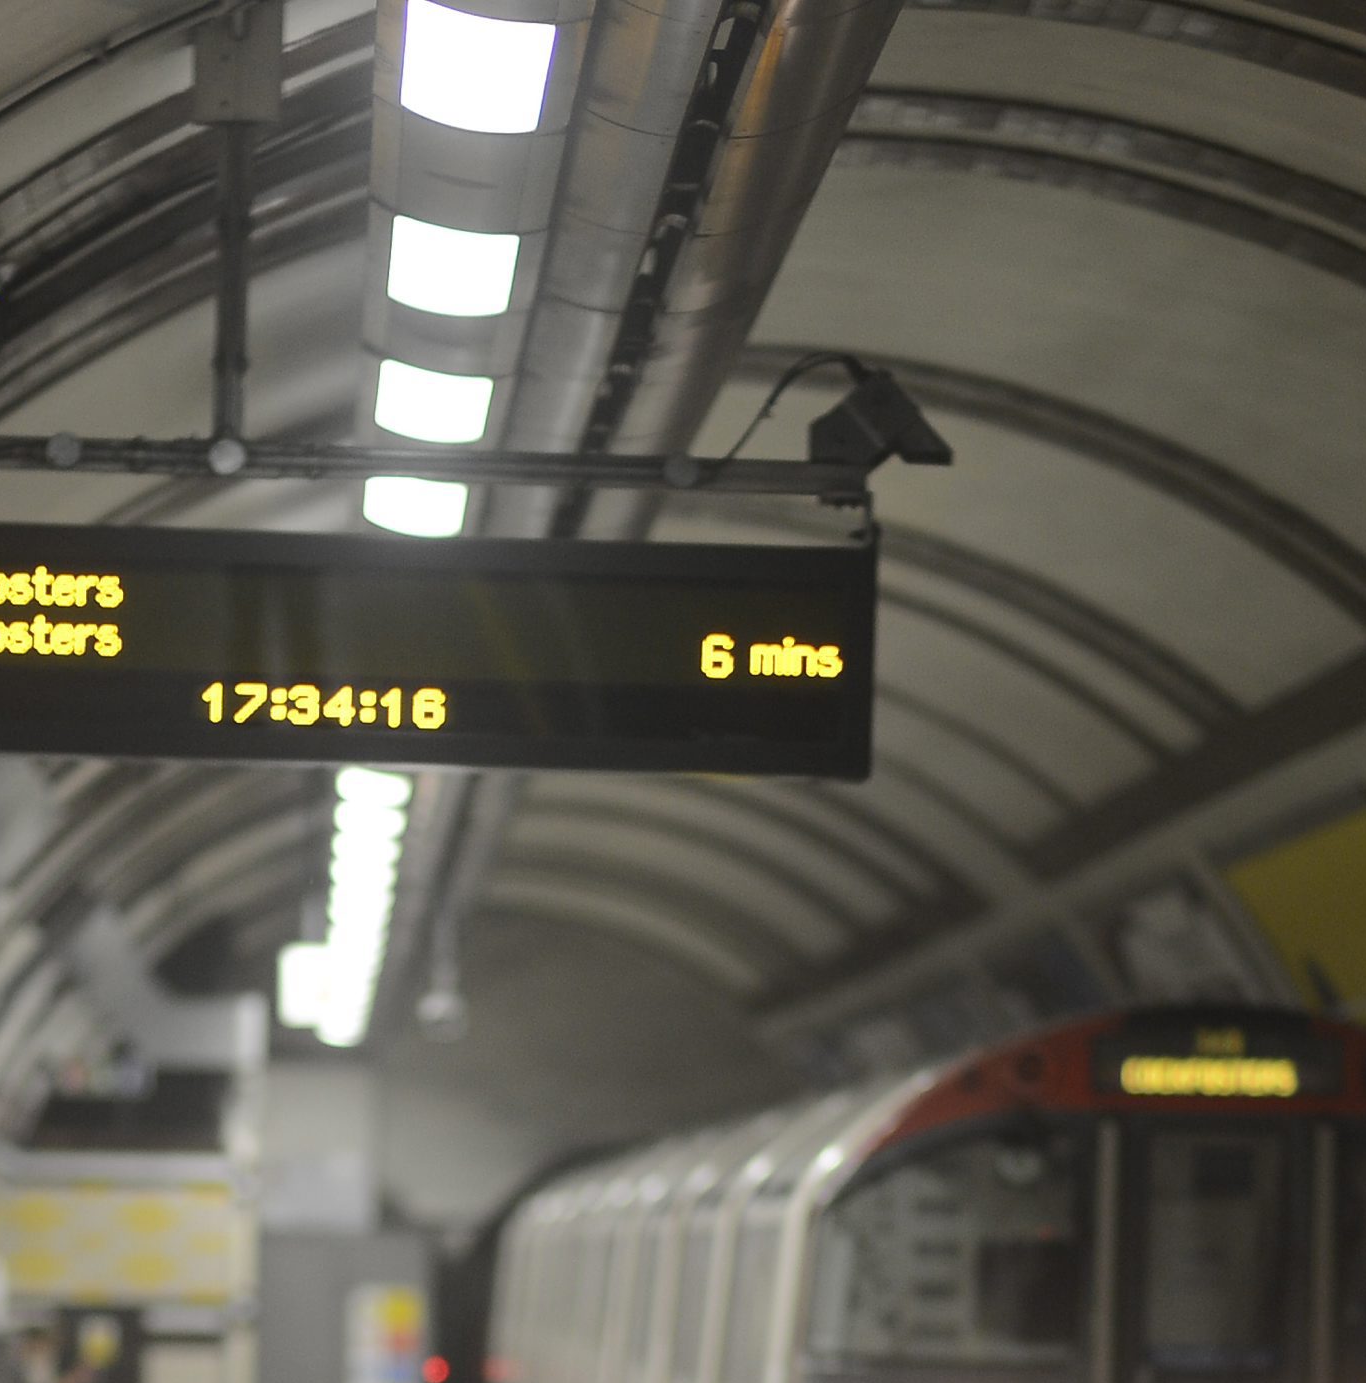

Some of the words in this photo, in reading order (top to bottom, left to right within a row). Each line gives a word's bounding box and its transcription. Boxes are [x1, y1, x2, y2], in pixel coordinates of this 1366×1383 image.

[700, 632, 736, 680] 6
[748, 635, 844, 679] mins
[201, 681, 447, 731] 17:34:16
